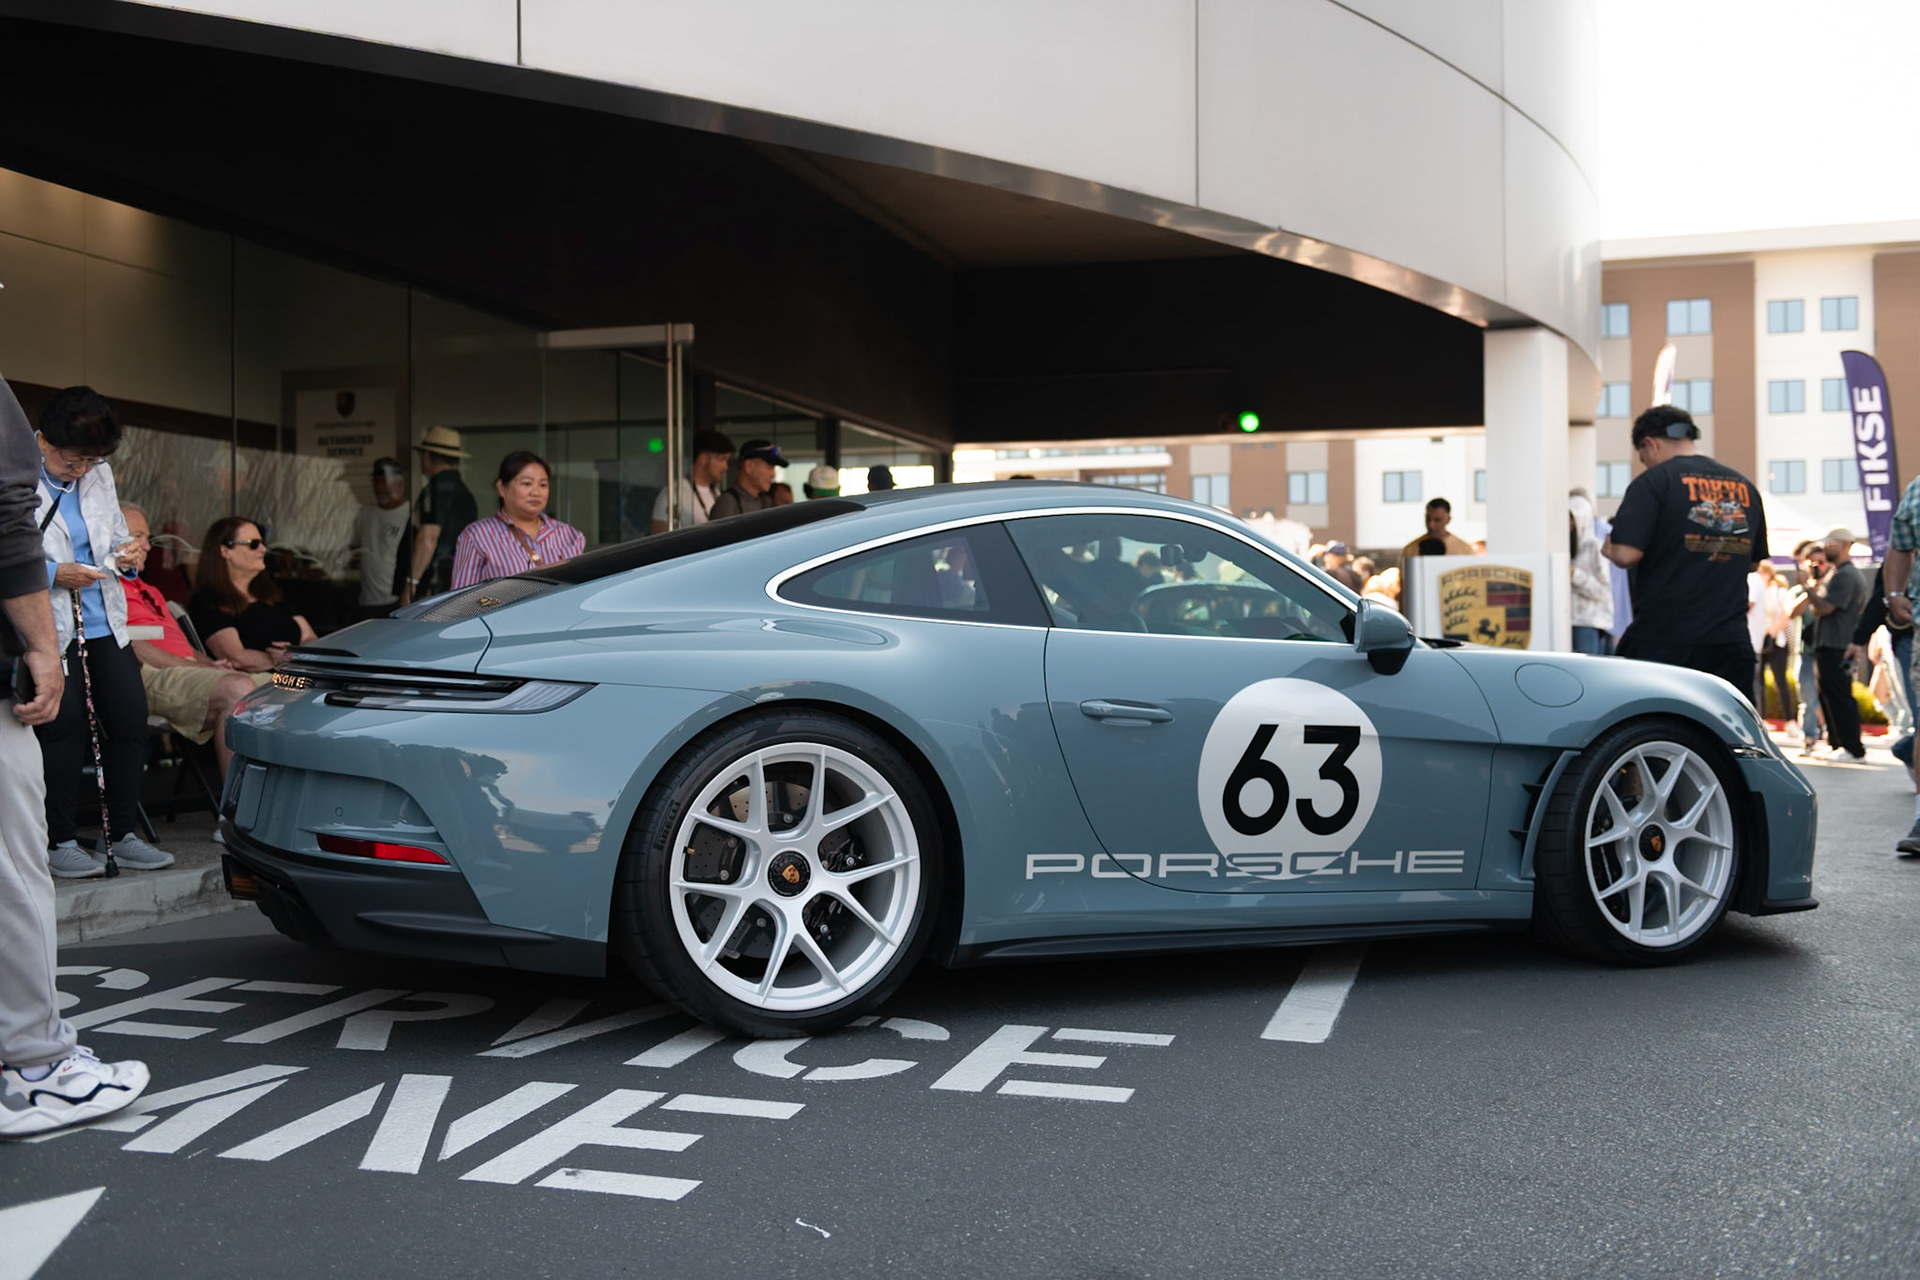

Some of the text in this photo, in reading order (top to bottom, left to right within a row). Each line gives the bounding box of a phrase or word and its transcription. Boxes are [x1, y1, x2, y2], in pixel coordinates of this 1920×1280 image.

[1852, 385, 1892, 512] FIKSE
[1681, 476, 1750, 508] TOKYO
[1441, 566, 1530, 586] PORSCHE
[1222, 723, 1362, 836] 63
[653, 798, 682, 852] PIRELLI
[1025, 849, 1466, 879] PORSCHE
[22, 1064, 806, 1201] ANE
